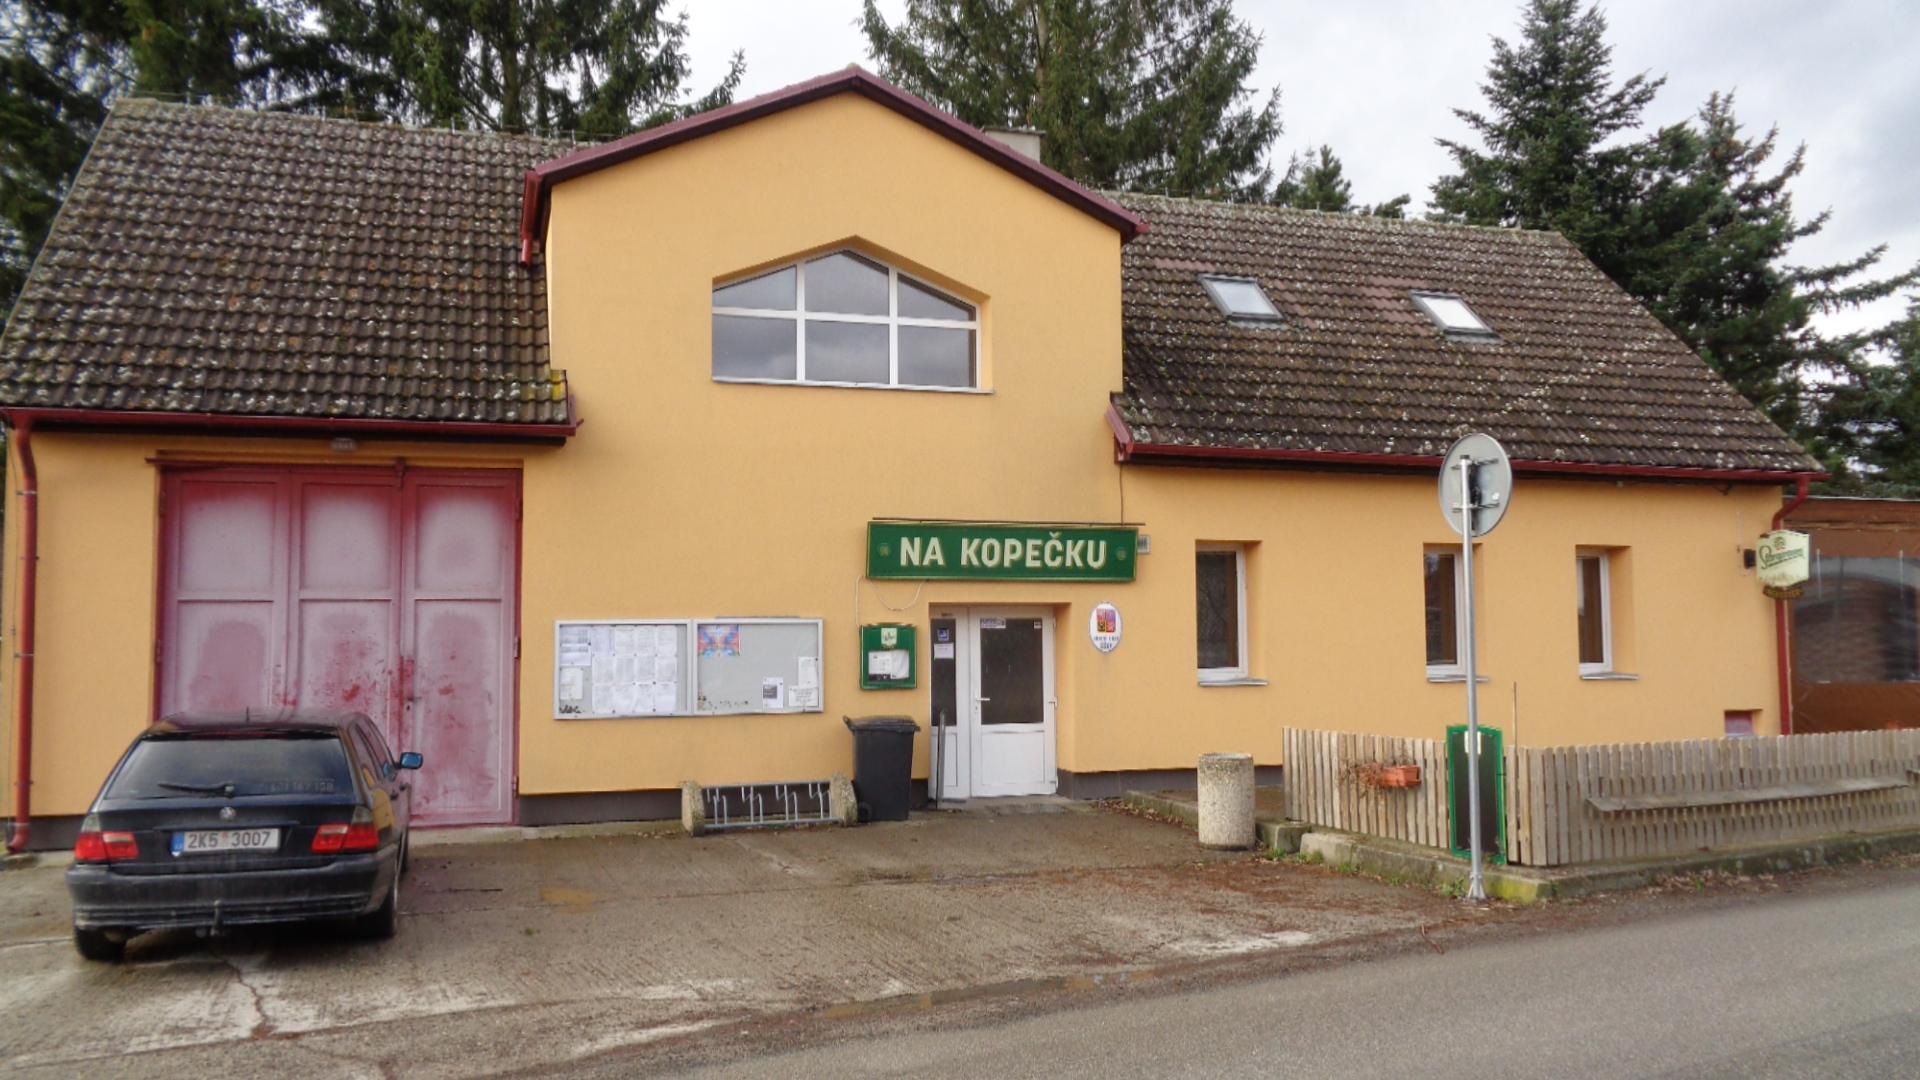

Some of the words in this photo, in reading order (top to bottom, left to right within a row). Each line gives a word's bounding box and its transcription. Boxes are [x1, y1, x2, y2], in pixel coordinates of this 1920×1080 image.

[900, 536, 945, 567] NA
[960, 531, 1107, 569] KOPEČKU
[187, 832, 219, 849] 2K5
[231, 831, 271, 847] 3007
